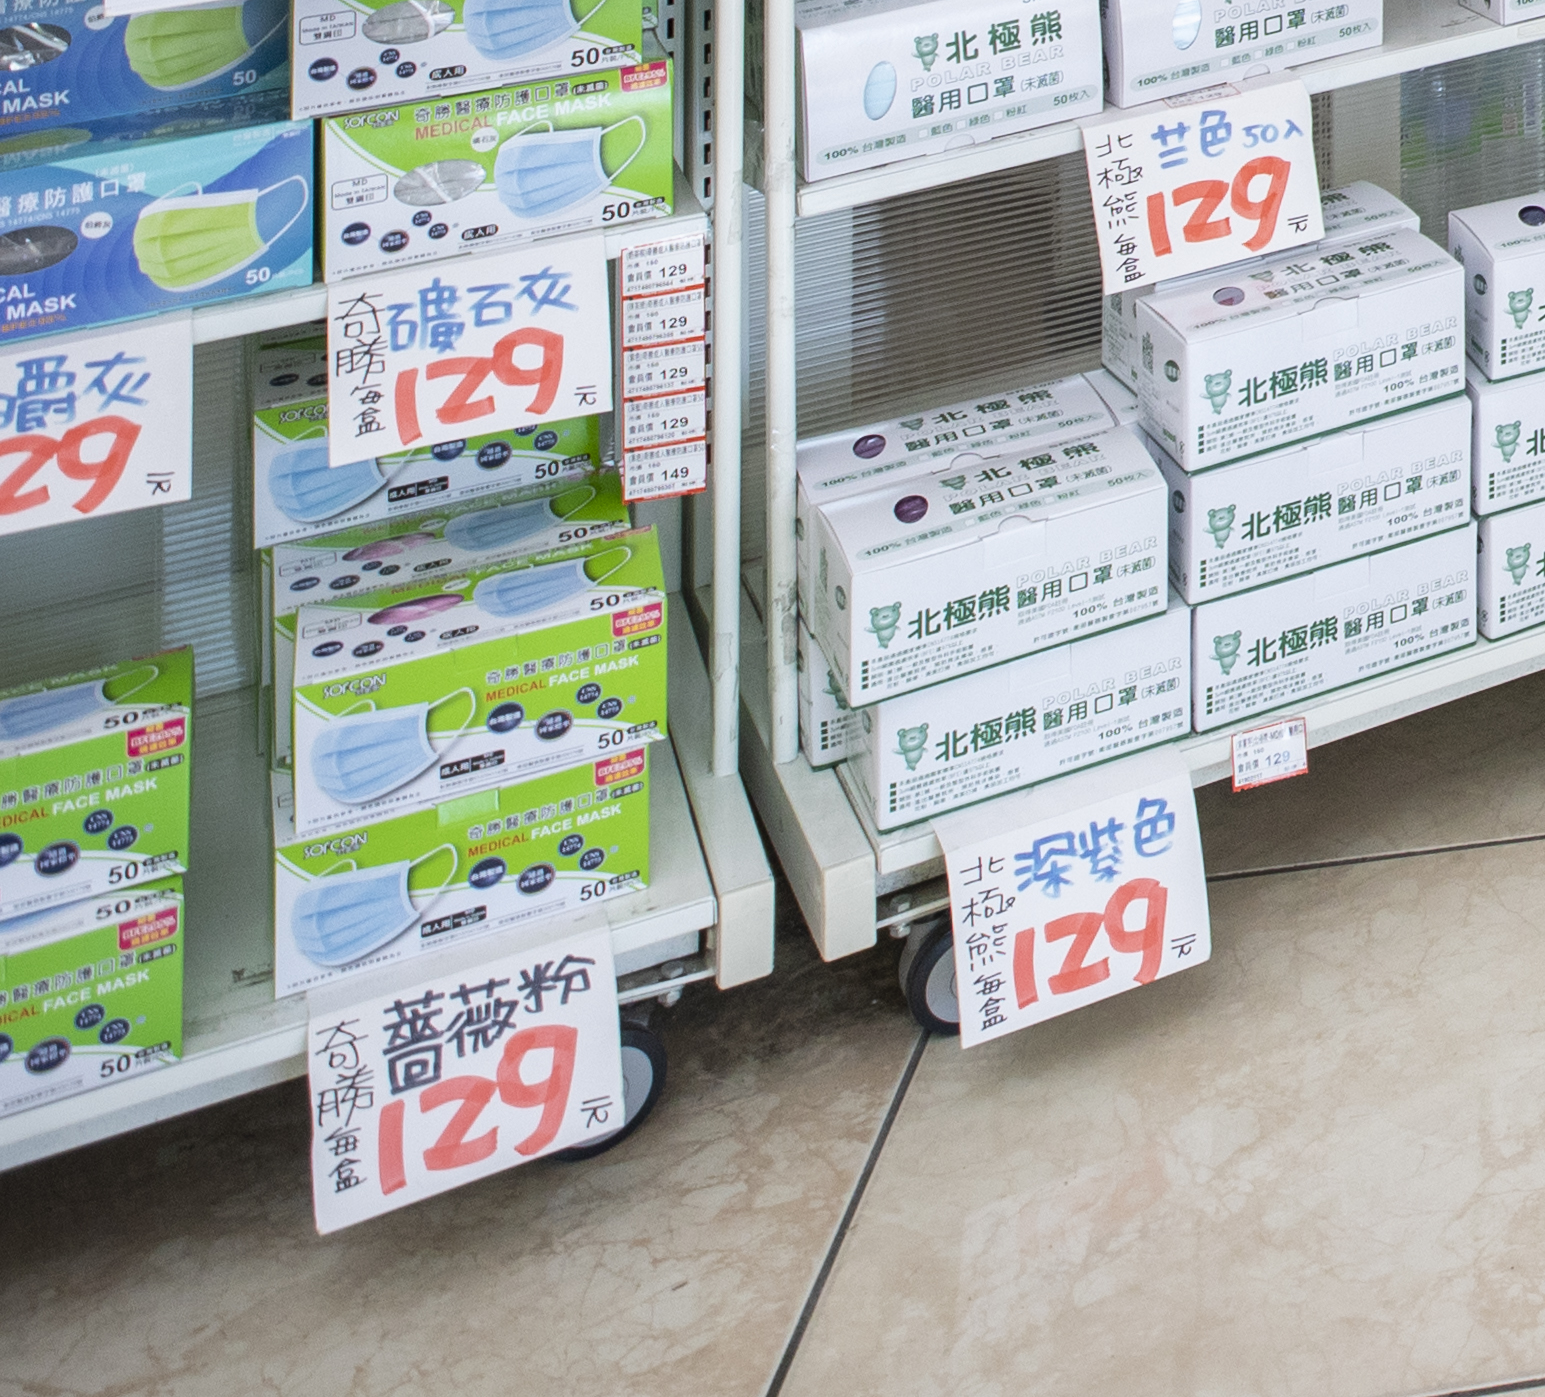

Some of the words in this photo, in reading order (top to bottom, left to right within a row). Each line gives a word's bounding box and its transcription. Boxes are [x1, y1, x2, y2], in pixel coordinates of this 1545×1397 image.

[496, 102, 551, 125] FACE
[602, 202, 631, 221] 50
[1146, 156, 1291, 258] 129
[659, 263, 688, 278] 129
[659, 315, 688, 329] 129
[394, 326, 565, 446] 129
[1238, 357, 1329, 408] 北極熊
[661, 467, 690, 481] 149
[1012, 878, 1168, 1010] 129
[378, 1024, 579, 1196] 129
